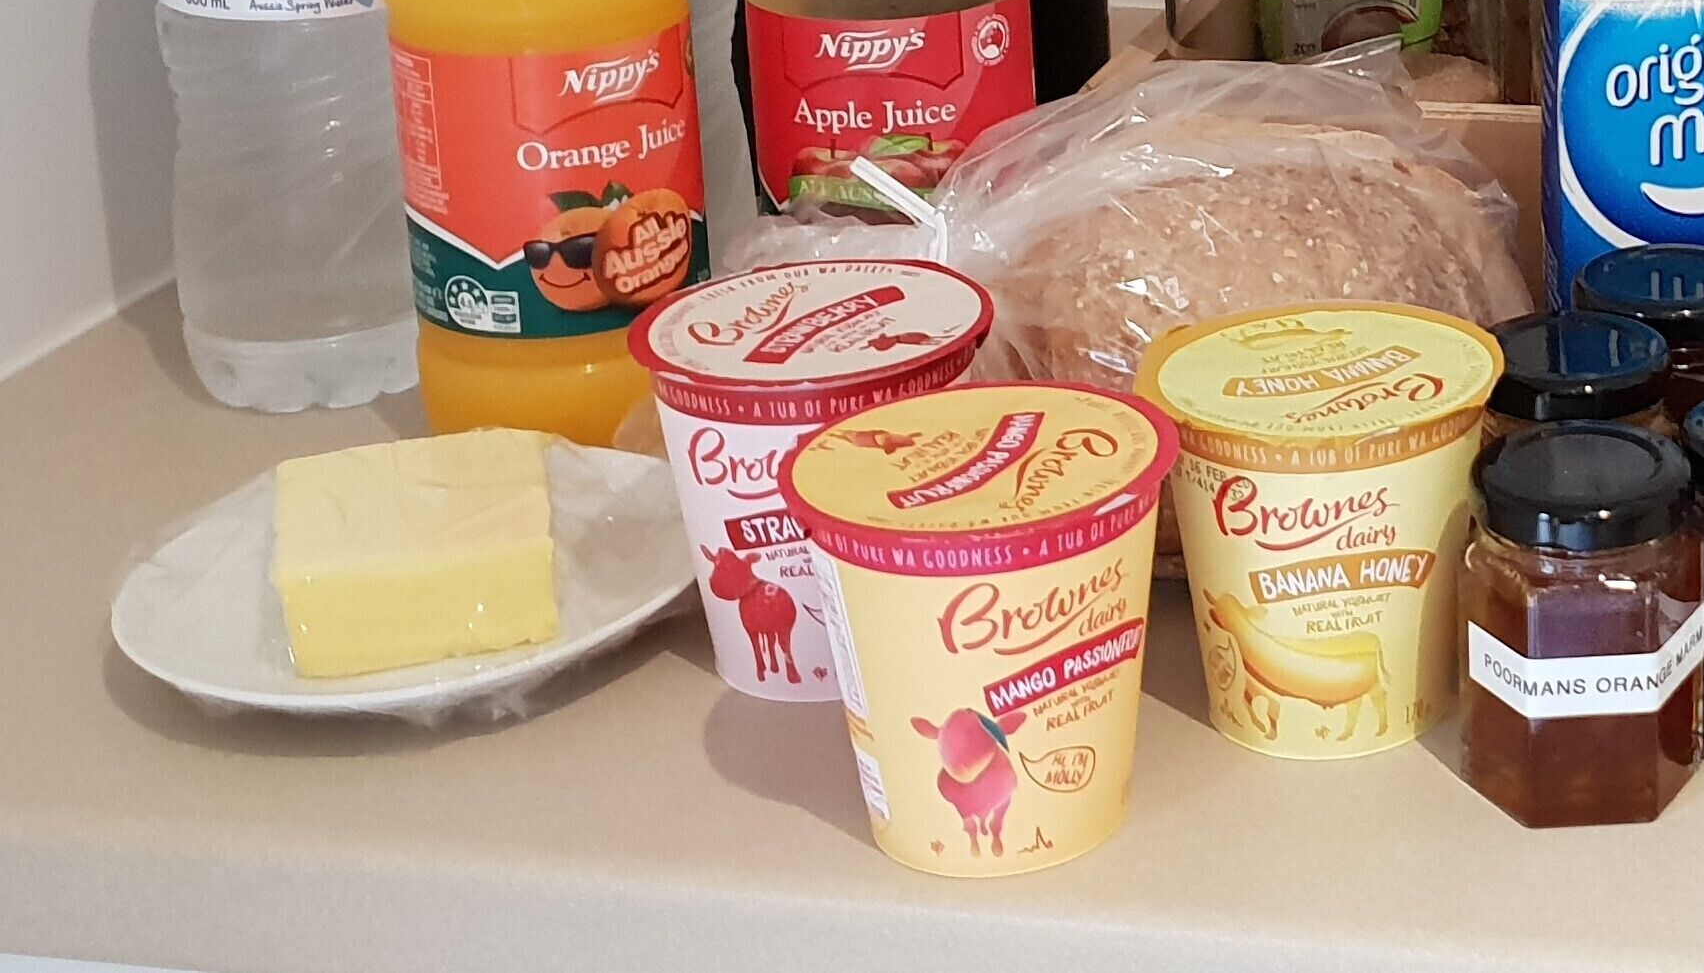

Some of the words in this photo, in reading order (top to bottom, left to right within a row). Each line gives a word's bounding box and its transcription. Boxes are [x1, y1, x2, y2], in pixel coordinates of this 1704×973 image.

[815, 27, 927, 71] Nippy's
[558, 49, 661, 100] Nippy's
[793, 97, 873, 135] Apple
[882, 99, 957, 134] Juice
[516, 137, 631, 172] Orange
[637, 118, 687, 160] Juice
[1321, 348, 1413, 385] BANANA
[670, 385, 731, 416] GOODNESS
[768, 400, 798, 418] TUB
[830, 394, 865, 415] PURE
[1235, 377, 1321, 398] HONEY
[1368, 440, 1401, 460] PURE
[1212, 475, 1400, 537] Brownes
[853, 542, 885, 565] PURE
[890, 546, 916, 568] WA
[922, 544, 1014, 571] GOODNESS
[1038, 538, 1049, 557] A
[1056, 527, 1084, 553] TUB
[1335, 522, 1397, 551] dairy
[779, 564, 815, 578] REAL
[1257, 562, 1350, 600] BANANA
[1359, 553, 1430, 585] HONEY
[937, 557, 1129, 655] Brownes
[1078, 597, 1127, 637] dairy
[1306, 617, 1342, 634] REAL
[1345, 610, 1384, 630] FRUIT
[988, 665, 1057, 711] MANGO
[1483, 652, 1587, 698] POORMANS
[1595, 662, 1673, 695] ORANGE
[1045, 707, 1081, 732] REAL
